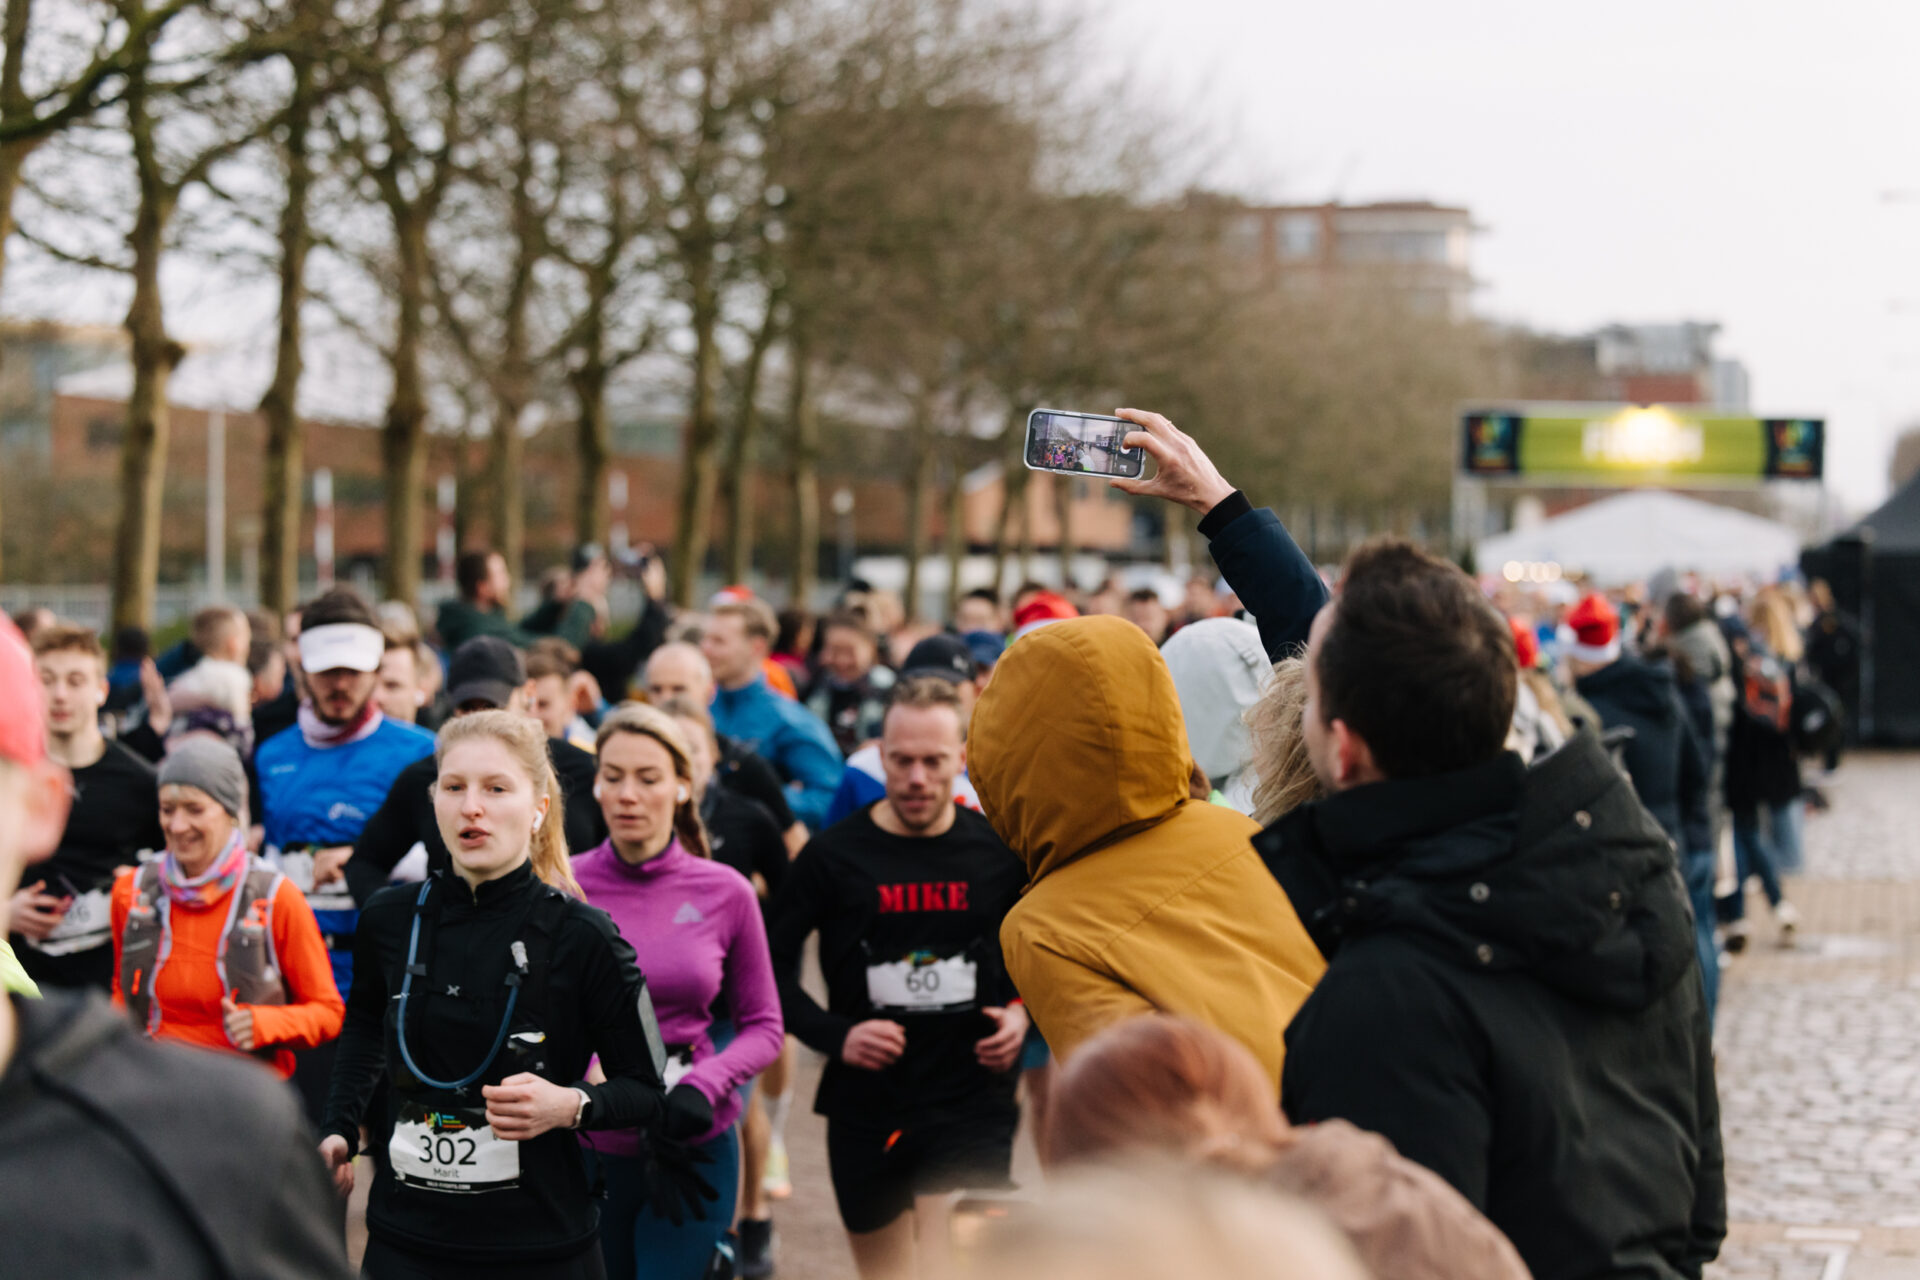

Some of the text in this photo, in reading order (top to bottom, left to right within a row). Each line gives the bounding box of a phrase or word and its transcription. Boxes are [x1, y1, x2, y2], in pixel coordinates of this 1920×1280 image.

[877, 881, 969, 913] MIKE
[905, 969, 940, 993] 60
[418, 1135, 477, 1166] 302
[433, 1167, 460, 1179] Marit
